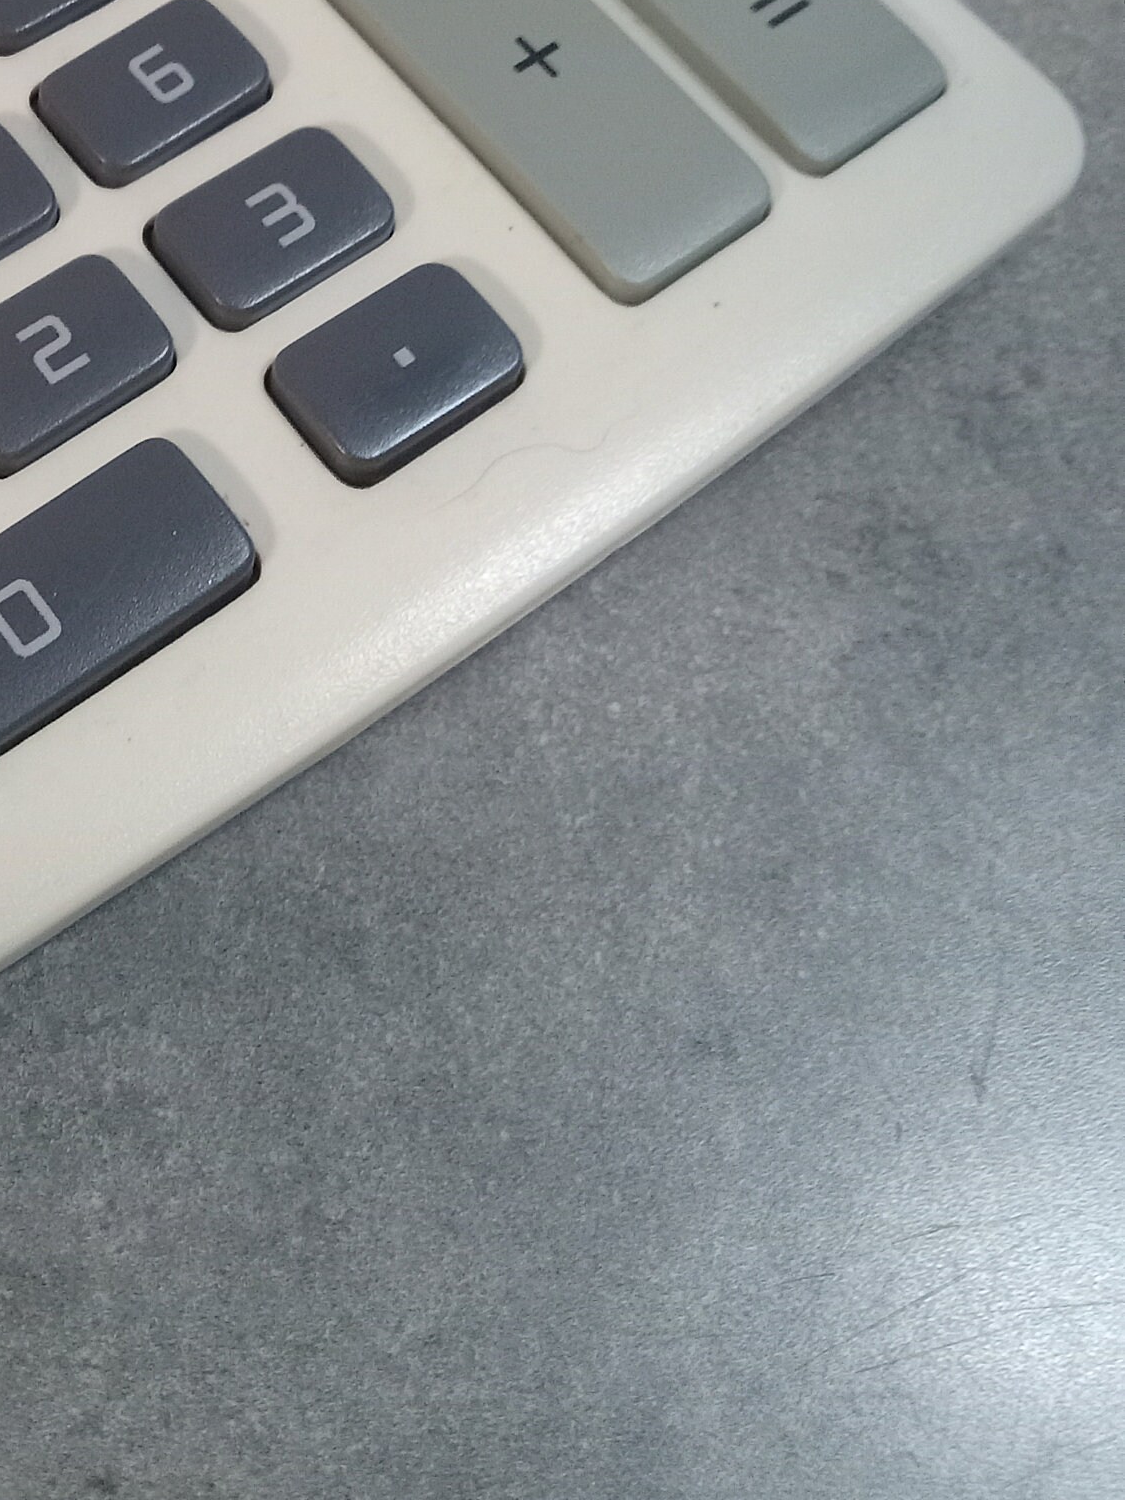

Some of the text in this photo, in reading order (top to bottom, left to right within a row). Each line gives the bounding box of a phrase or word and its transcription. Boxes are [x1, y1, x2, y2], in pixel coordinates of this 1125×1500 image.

[128, 43, 195, 104] 6
[244, 182, 316, 249] 3
[15, 314, 90, 386] 2
